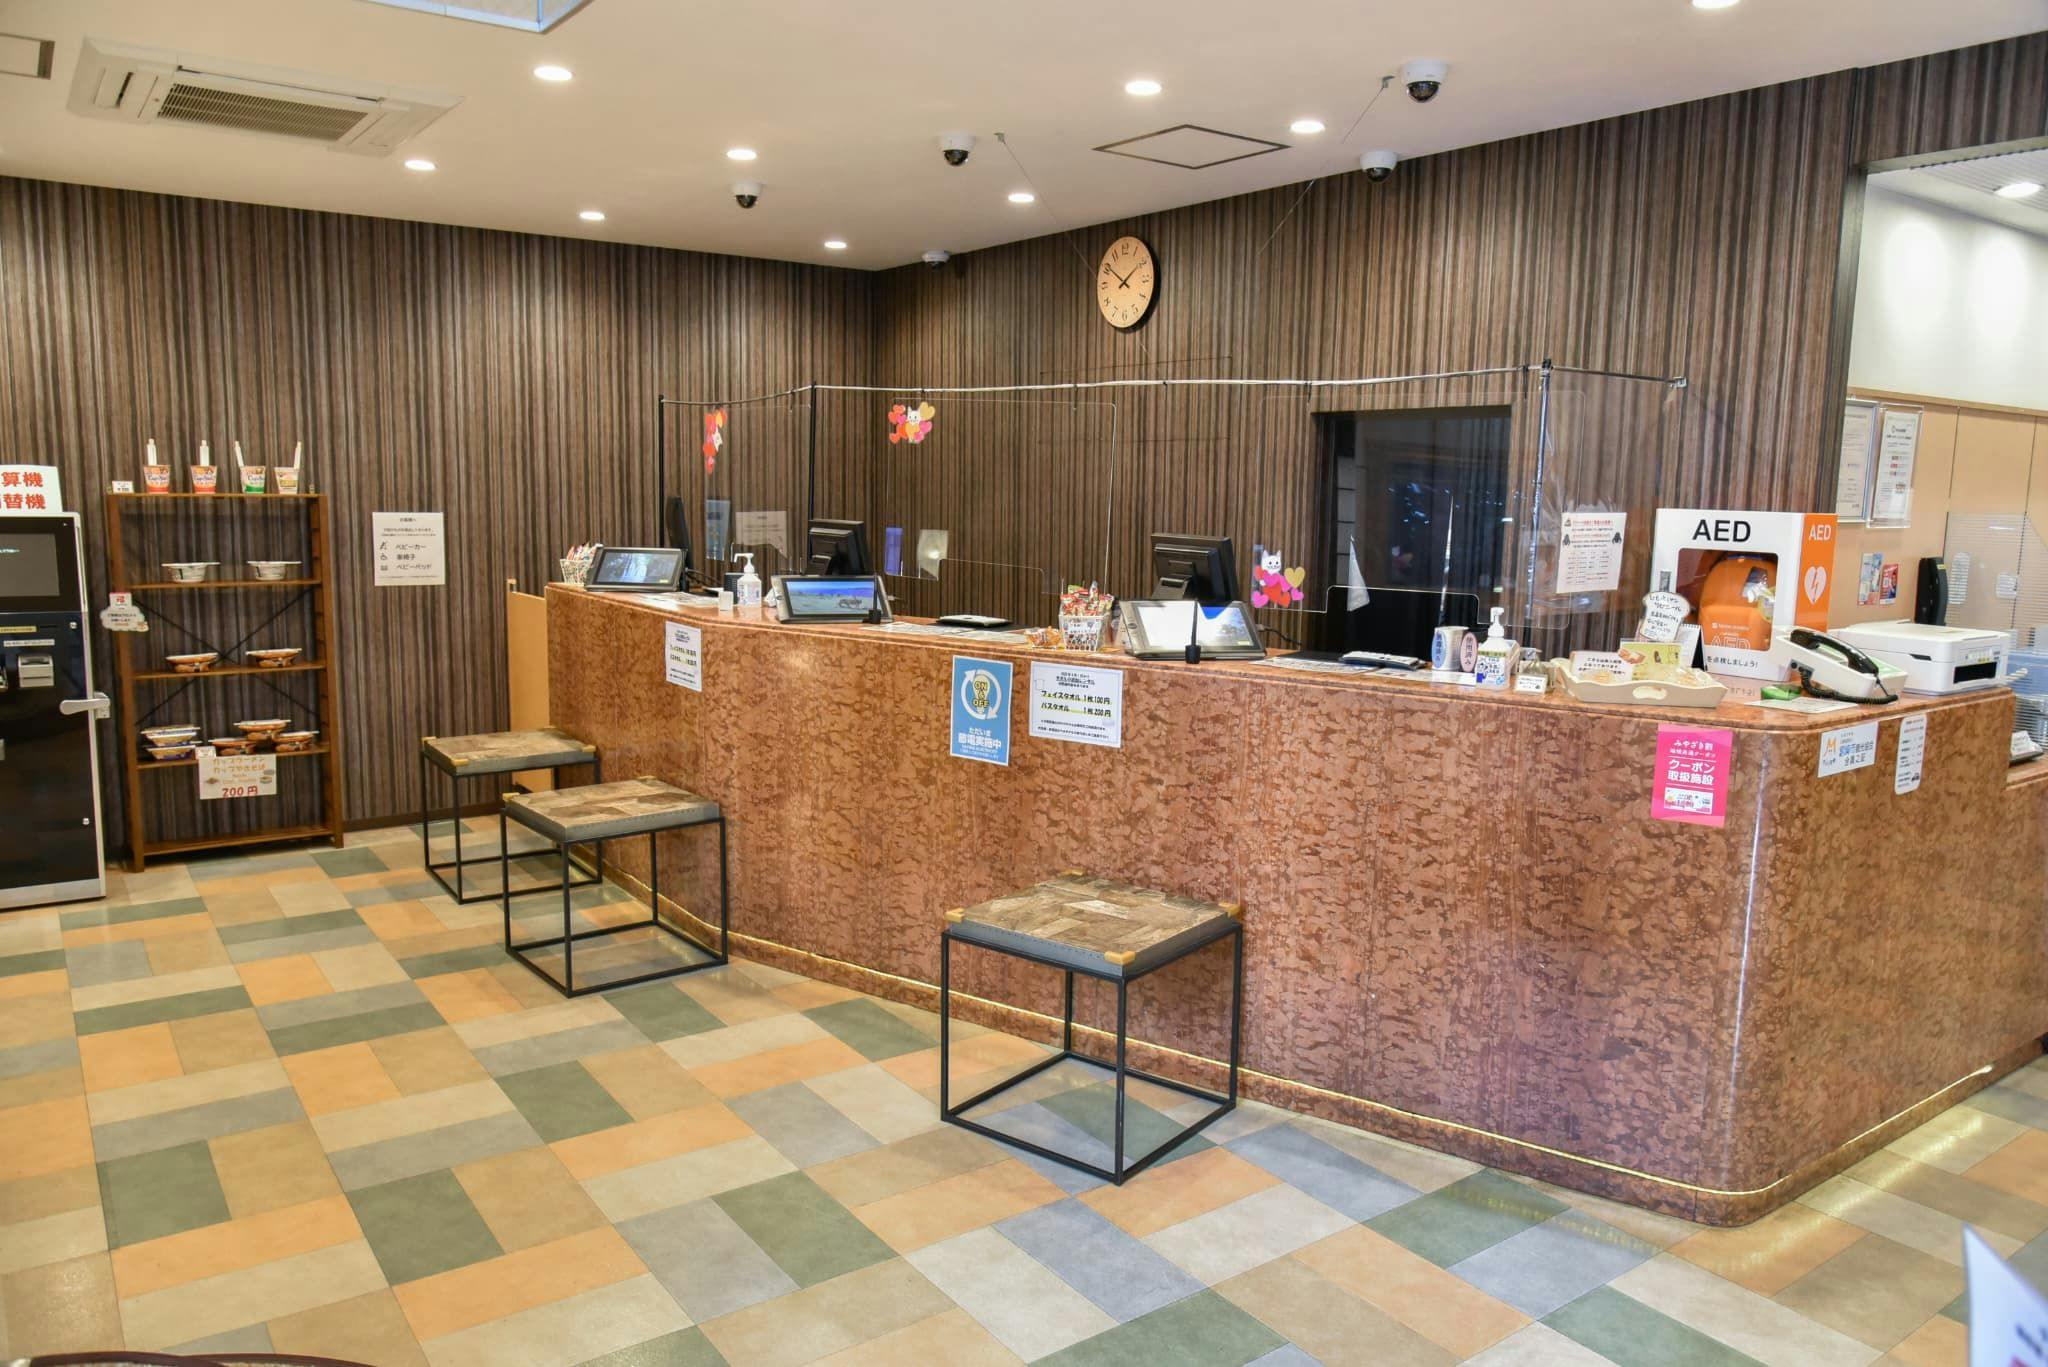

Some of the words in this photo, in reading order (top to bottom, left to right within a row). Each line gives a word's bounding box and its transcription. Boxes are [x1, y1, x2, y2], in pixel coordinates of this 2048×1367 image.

[0, 493, 46, 509] 替機
[1692, 519, 1751, 542] AED
[1808, 524, 1832, 541] AED
[974, 681, 988, 691] ON
[1041, 690, 1080, 701] フェイスタオル
[972, 700, 989, 708] OFF
[1041, 702, 1070, 712] バスタオル
[958, 732, 1002, 750] 節電実施中
[1669, 759, 1715, 774] クーポン
[1667, 770, 1714, 785] 取扱施設
